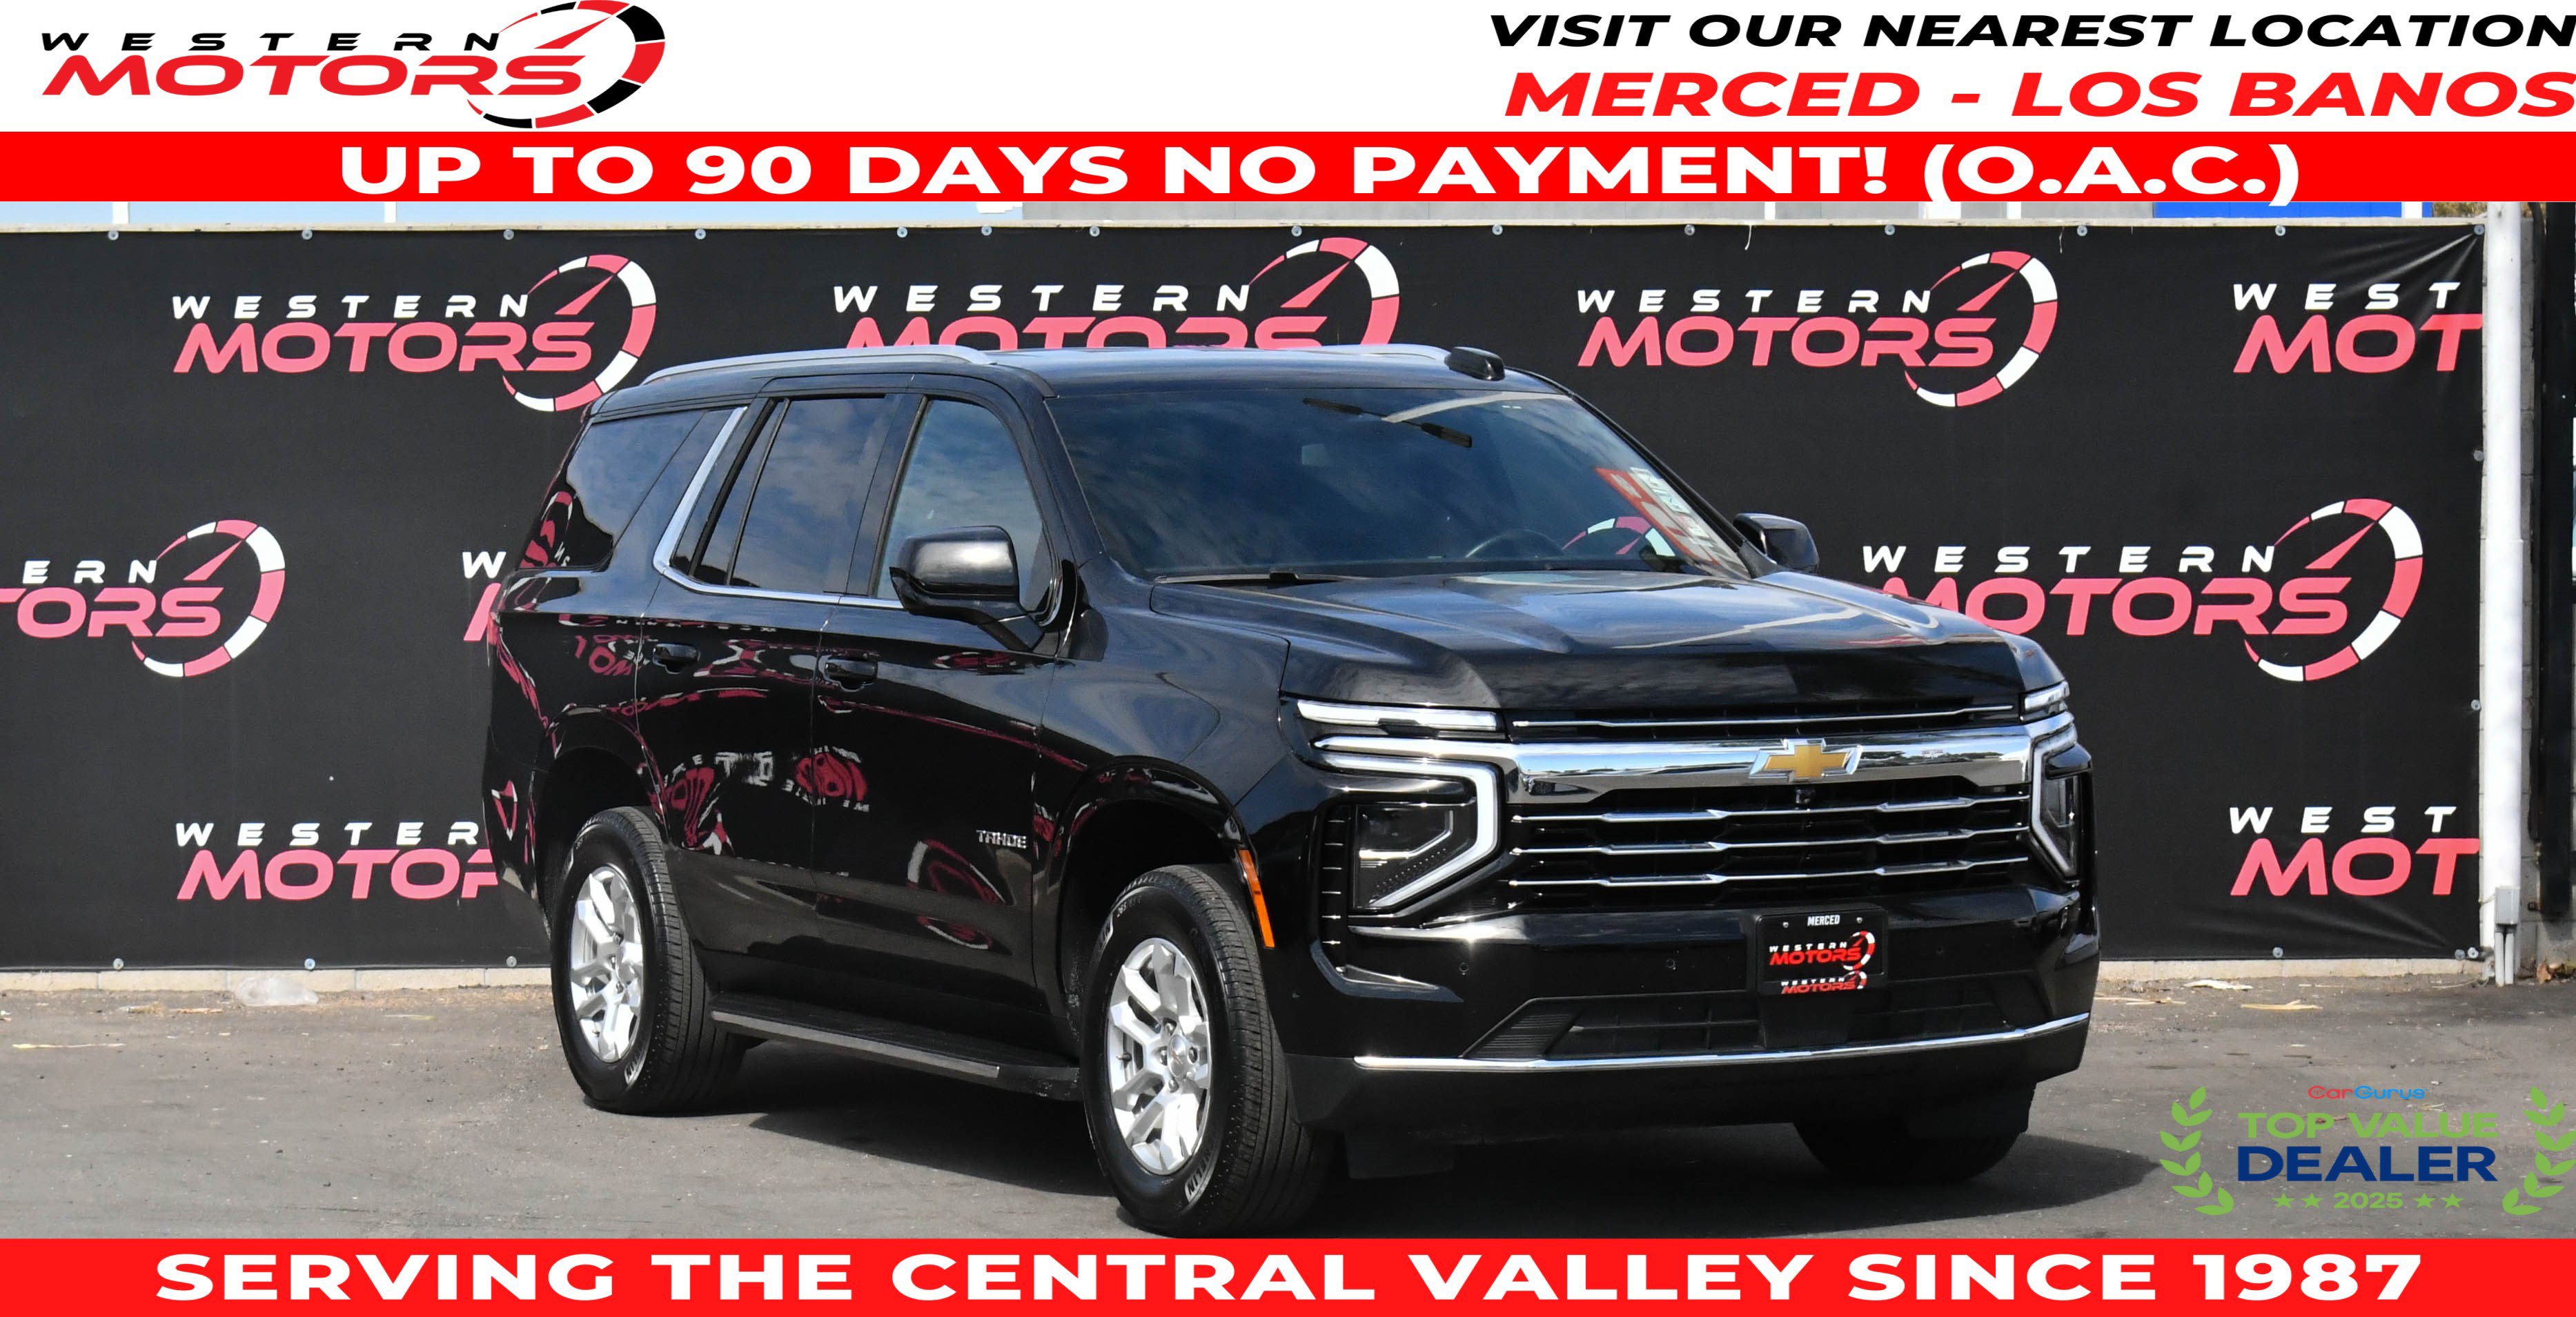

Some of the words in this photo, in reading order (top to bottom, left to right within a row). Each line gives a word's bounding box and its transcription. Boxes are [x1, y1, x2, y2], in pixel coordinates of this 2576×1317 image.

[172, 294, 528, 319] WESTERN
[833, 284, 1250, 312] WESTERN
[1577, 289, 1931, 313] WESTERN
[2233, 282, 2461, 310] WEST
[174, 321, 594, 373] MOTORS
[1578, 315, 1996, 368] MOTORS
[2233, 313, 2483, 373] MOT
[1863, 545, 2275, 573] WESTERN
[0, 587, 224, 639] ORS
[2229, 806, 2457, 834] WEST
[976, 830, 1026, 849] TAHOE
[2230, 837, 2479, 896] MOT
[1807, 914, 1840, 927] MERCED
[1769, 942, 1847, 952] WESTERN
[1769, 947, 1862, 966] MOTORS
[1781, 977, 1845, 987] WESTERN
[1781, 980, 1856, 994] MOTORS
